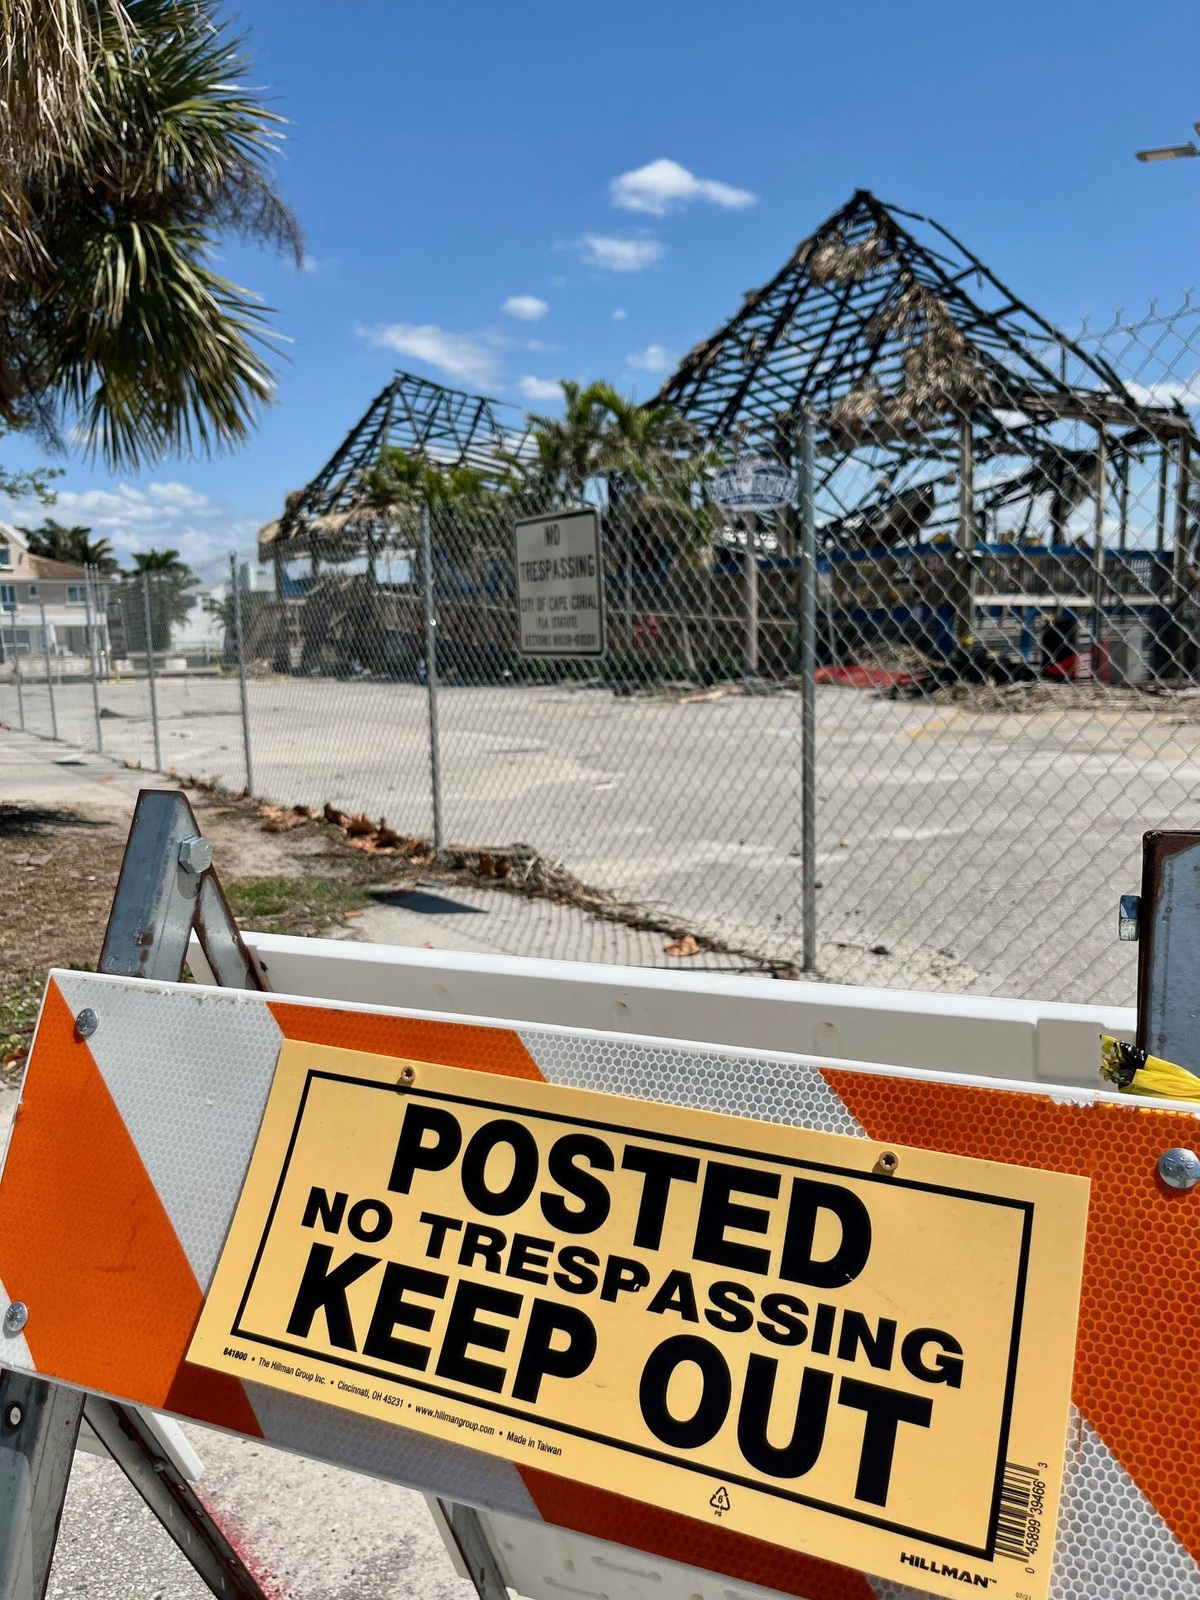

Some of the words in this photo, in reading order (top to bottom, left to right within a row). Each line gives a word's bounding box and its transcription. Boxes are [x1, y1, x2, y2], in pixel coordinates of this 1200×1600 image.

[544, 524, 560, 546] NO
[520, 555, 595, 582] TRESPASSING
[521, 598, 534, 612] CITY
[537, 597, 546, 612] OF
[549, 596, 568, 611] CAPE
[571, 594, 598, 610] CORAL
[387, 1103, 872, 1289] POSTED
[301, 1186, 393, 1243] NO
[419, 1211, 964, 1389] TRESPASSING
[286, 1242, 598, 1404] KEEP
[639, 1334, 933, 1508] OUT
[222, 1347, 248, 1361] 841800
[258, 1357, 270, 1368] The
[270, 1361, 294, 1376] Hillman
[295, 1368, 314, 1382] Group
[315, 1373, 326, 1384] Inc.
[337, 1380, 370, 1399] Cincinnati,
[372, 1391, 382, 1401] OH
[383, 1395, 404, 1408] 45231
[415, 1404, 495, 1436] www.hillmangroup.com
[506, 1431, 527, 1445] Made
[527, 1437, 535, 1448] in
[537, 1440, 562, 1456] Taiwan
[1037, 1461, 1048, 1469] 3
[717, 1495, 724, 1504] 6
[1030, 1480, 1046, 1515] 39466
[1026, 1519, 1041, 1555] 45899
[1025, 1567, 1035, 1575] 0
